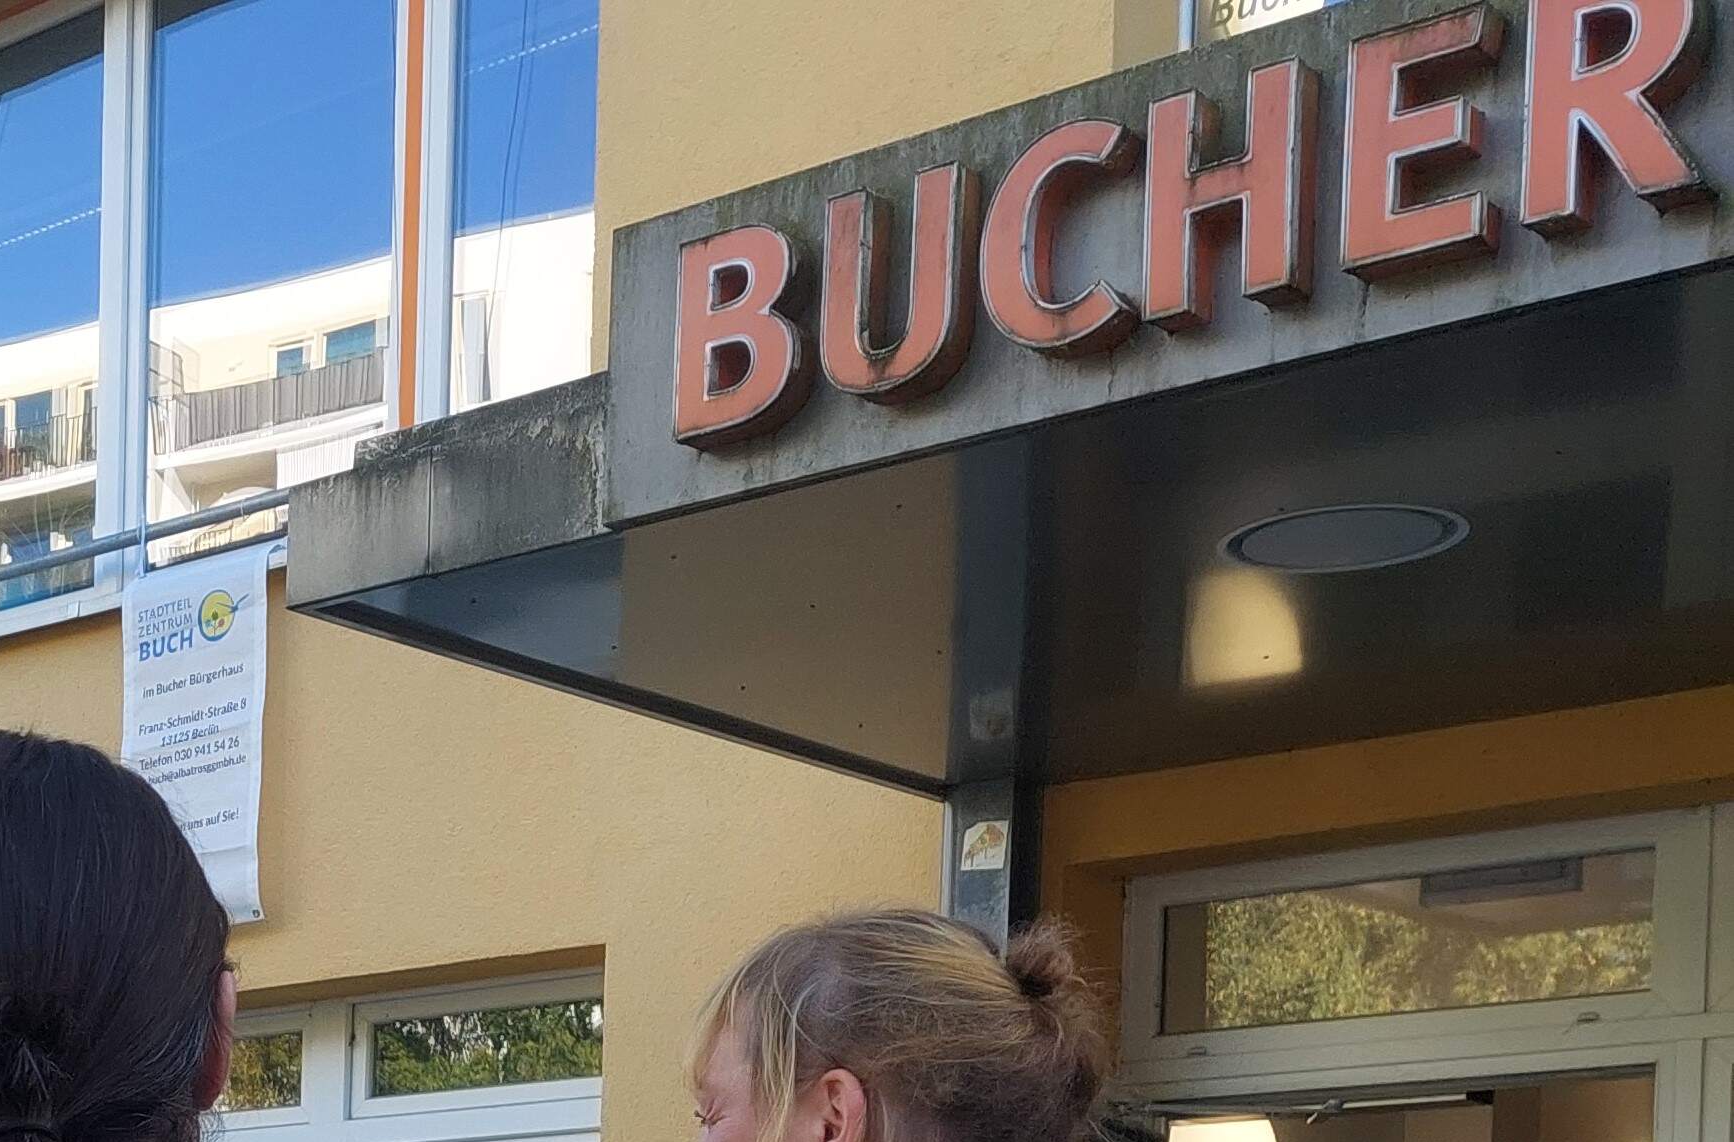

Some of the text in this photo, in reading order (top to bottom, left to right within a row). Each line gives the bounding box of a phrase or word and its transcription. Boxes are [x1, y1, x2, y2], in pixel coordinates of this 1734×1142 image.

[671, 0, 1719, 447] BUCHER
[137, 597, 193, 623] STADTTEIL
[138, 612, 193, 638] ZENTRUM
[138, 628, 194, 662] BUCH
[156, 678, 187, 696] Bucher
[189, 663, 244, 686] Bürgerhaus
[139, 700, 239, 737] Franz-Schmidt-Straße
[191, 723, 219, 741] Berlin
[139, 736, 240, 771] Telefon 030 941 54 26
[205, 812, 220, 827] auf
[221, 808, 240, 823] Sie!
